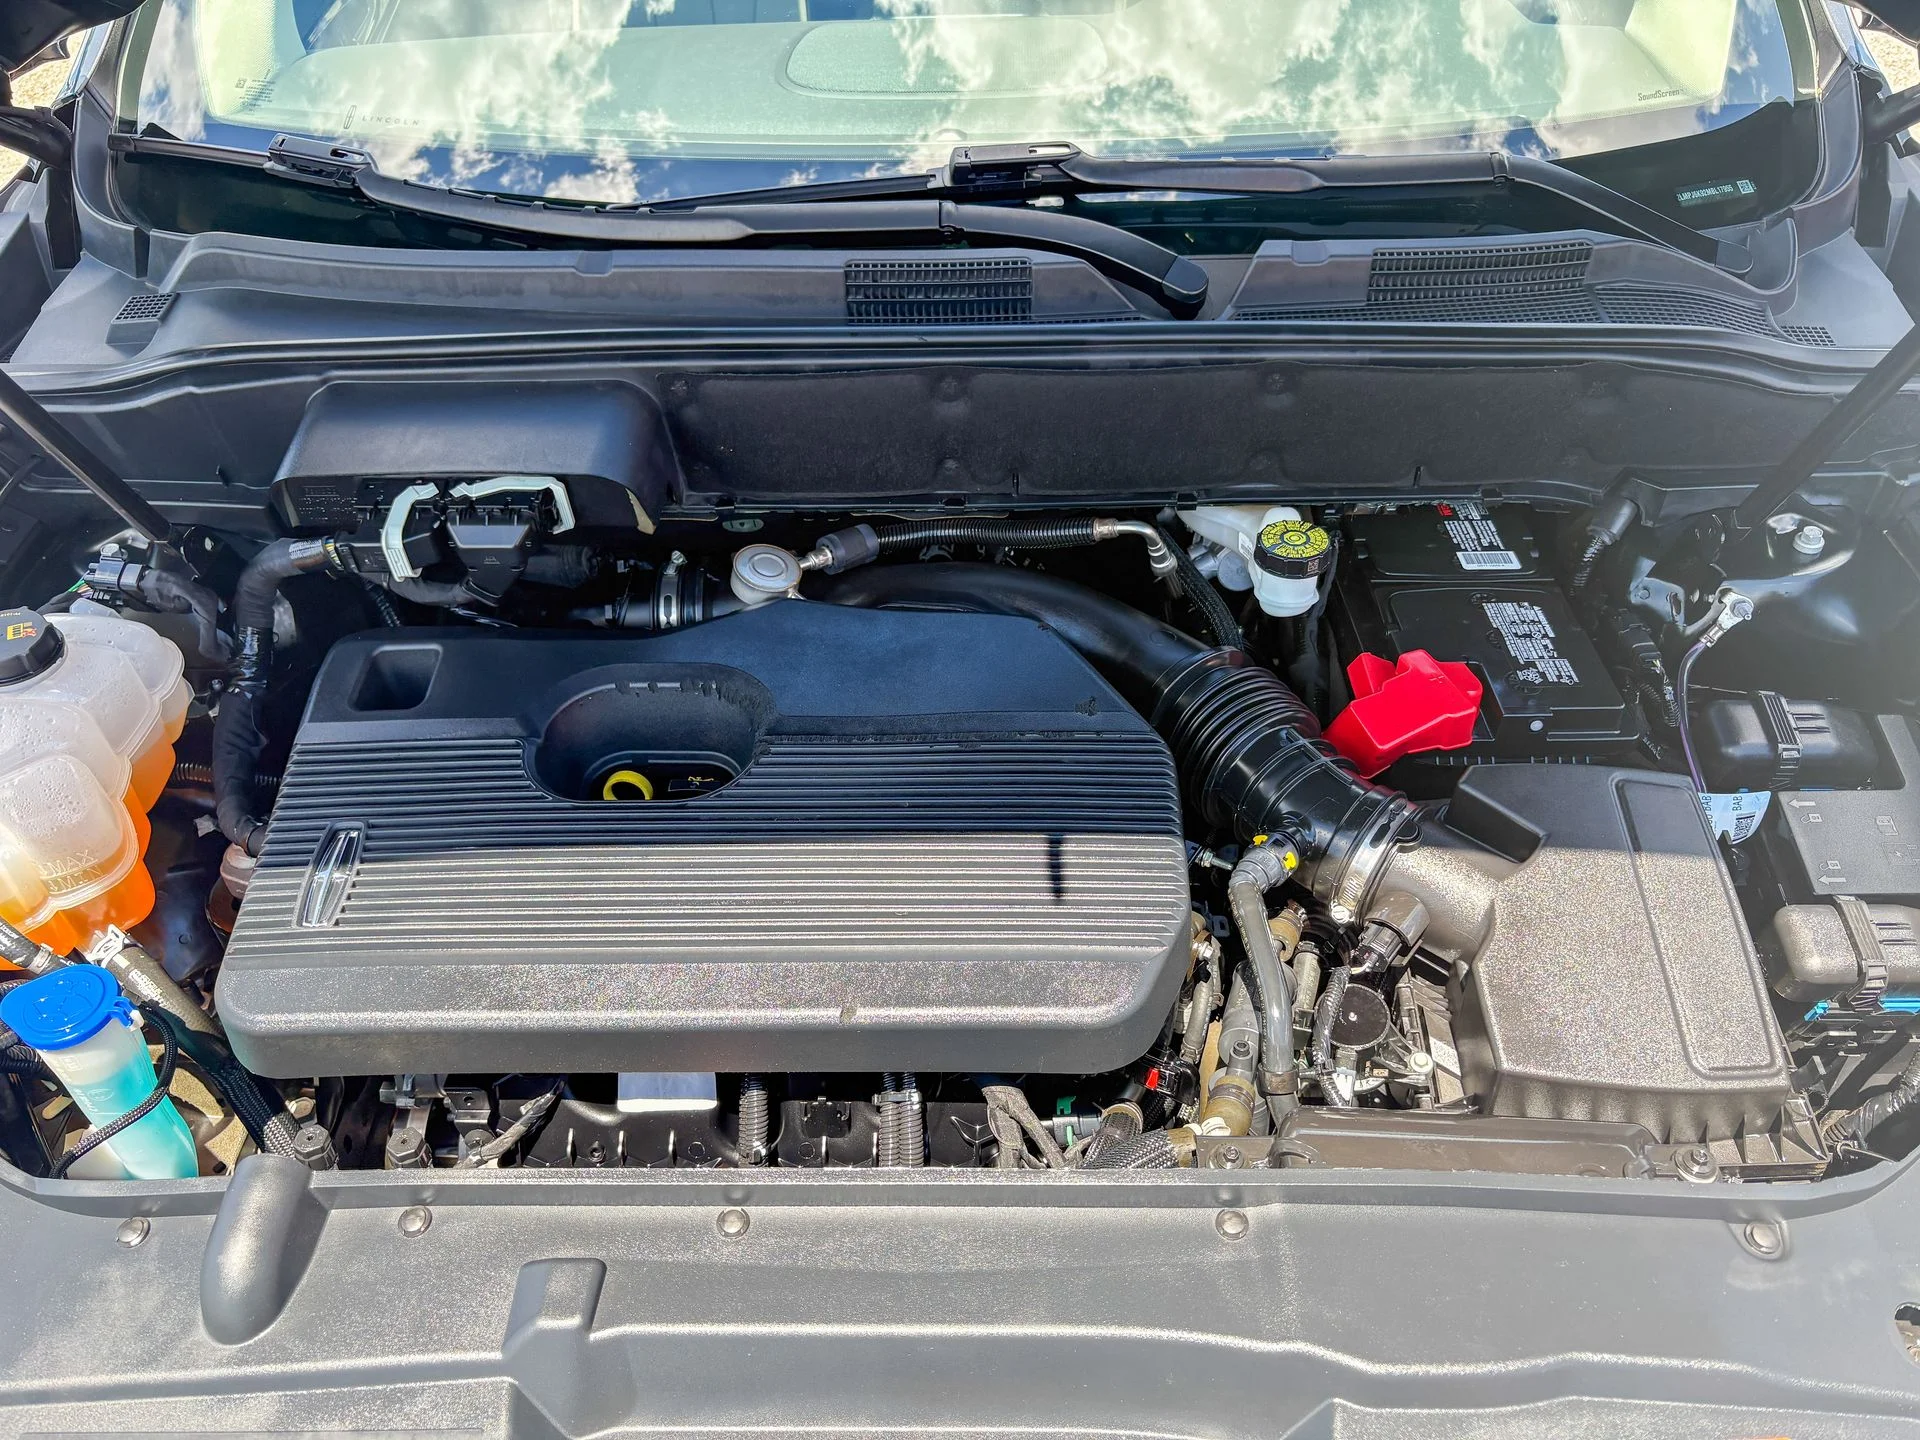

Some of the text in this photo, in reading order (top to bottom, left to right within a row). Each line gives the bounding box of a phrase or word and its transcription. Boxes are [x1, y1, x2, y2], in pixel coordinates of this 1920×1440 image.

[361, 115, 420, 126] LINCOLN
[1732, 795, 1743, 811] BAB
[43, 849, 94, 876] MAX
[56, 865, 104, 893] MIN
